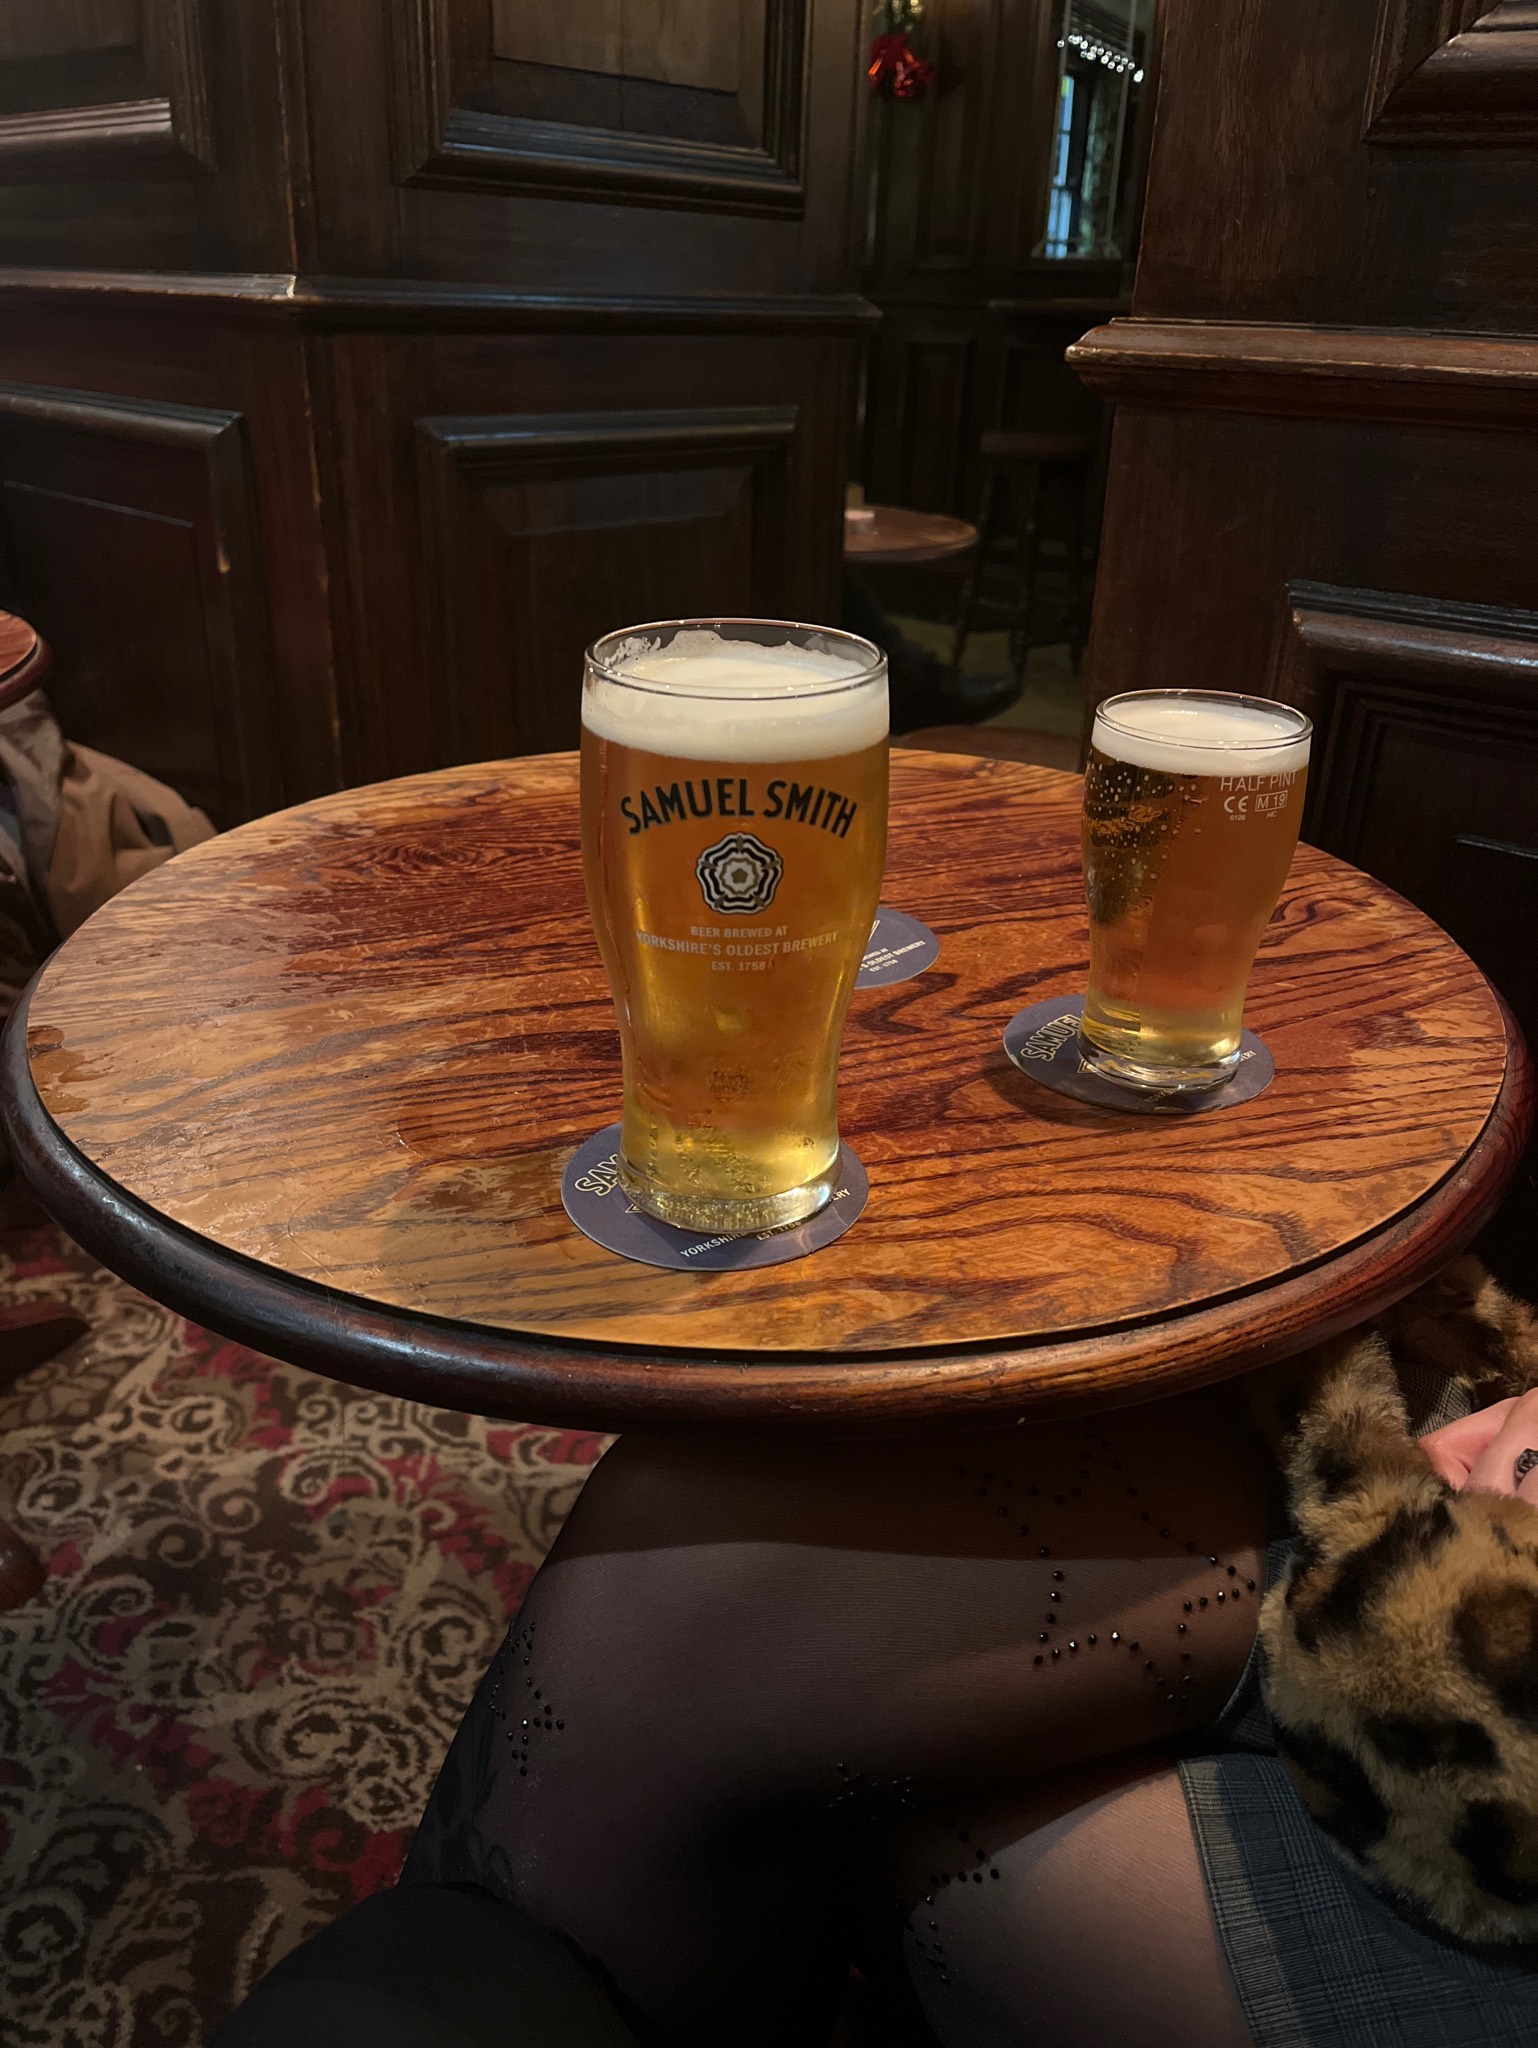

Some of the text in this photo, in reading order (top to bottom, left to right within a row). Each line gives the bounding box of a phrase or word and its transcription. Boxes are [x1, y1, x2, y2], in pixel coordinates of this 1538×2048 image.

[1220, 769, 1298, 792] HALF PINT
[620, 778, 858, 839] SAMUEL SMITH
[636, 929, 722, 956] YORKSHIRE'S
[726, 942, 780, 957] OLDEST
[782, 929, 839, 954] BREWERY
[690, 925, 788, 939] BEER BREWED AT
[711, 961, 766, 972] EST. 1758
[1020, 1013, 1081, 1062] SAMUE
